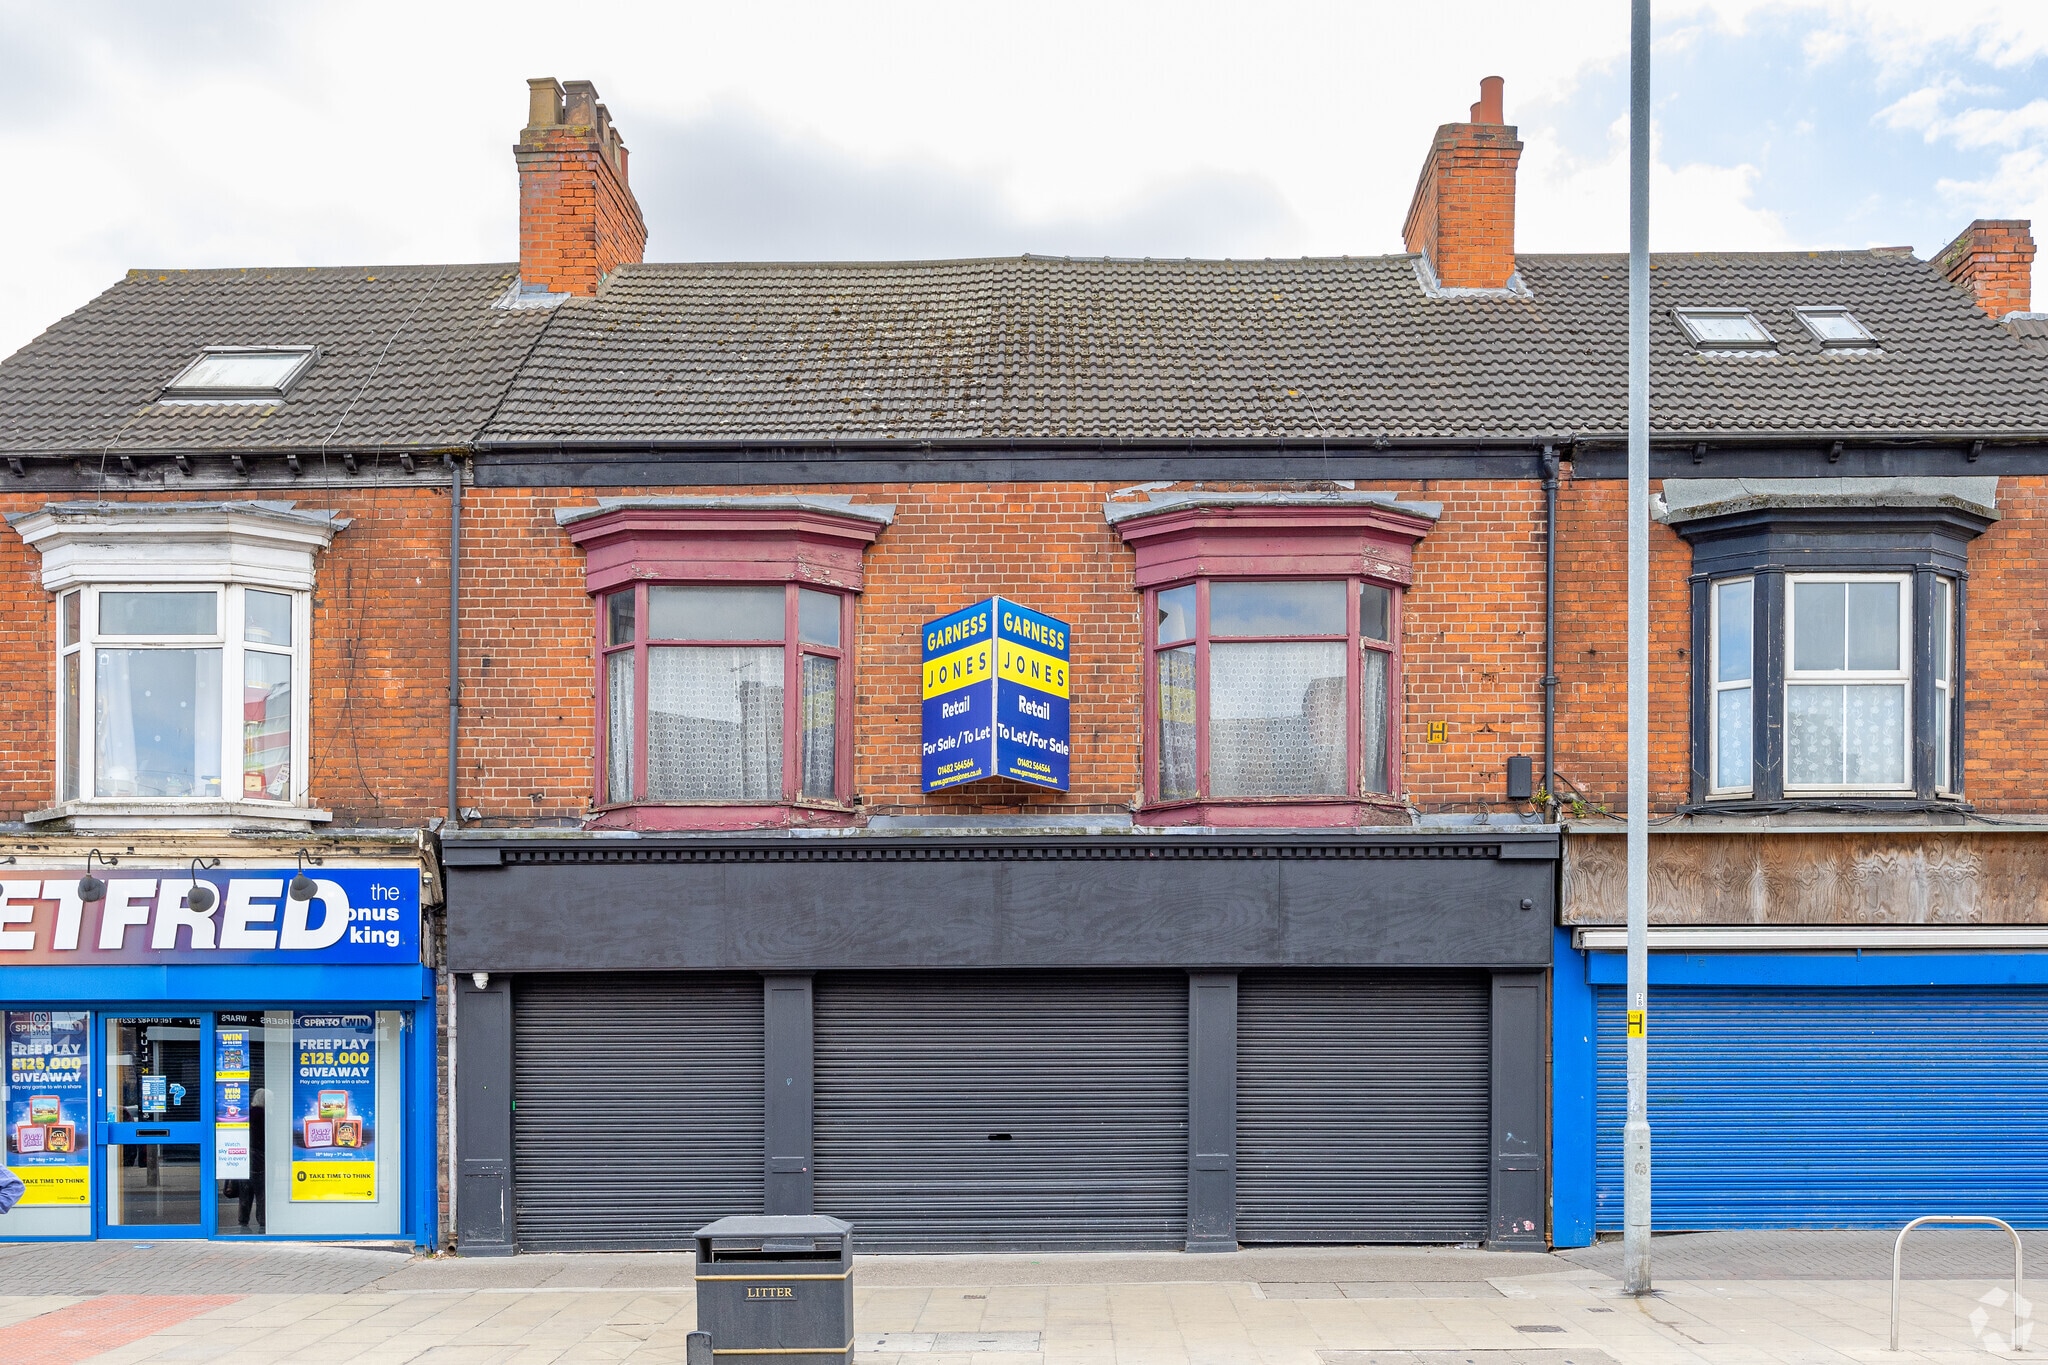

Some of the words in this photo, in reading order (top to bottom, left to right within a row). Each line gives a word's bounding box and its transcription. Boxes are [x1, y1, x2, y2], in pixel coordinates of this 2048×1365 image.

[927, 613, 987, 651] GARNESS
[1003, 612, 1064, 650] GARNESS
[928, 652, 986, 688] JONES
[1004, 652, 1064, 686] JONES
[942, 695, 970, 719] Retail
[1018, 695, 1049, 720] Retail
[923, 743, 936, 756] For
[937, 736, 956, 751] Sale
[956, 731, 963, 748] /
[963, 731, 973, 744] To
[975, 726, 990, 741] Let
[998, 722, 1010, 739] To
[1011, 727, 1048, 749] Let/For
[1049, 738, 1069, 755] Sale
[937, 764, 954, 776] 01482
[954, 758, 974, 771] 564564
[1017, 758, 1032, 768] 01482
[1033, 762, 1050, 773] 564564
[371, 883, 400, 900] the
[348, 907, 400, 921] onus
[350, 926, 400, 947] king
[304, 1019, 326, 1027] SPIN
[327, 1019, 340, 1027] TO
[345, 1018, 368, 1027] WIN
[1628, 1013, 1642, 1034] H
[222, 1033, 242, 1041] WIN
[300, 1039, 331, 1050] FREE
[333, 1039, 369, 1050] PLAY
[11, 1042, 42, 1055] FREE
[45, 1043, 81, 1055] PLAY
[12, 1057, 82, 1071] £125,000
[300, 1052, 369, 1066] £125,000
[12, 1072, 81, 1082] GIVEAWAY
[300, 1067, 369, 1077] GIVEAWAY
[747, 1287, 793, 1298] LITTER
